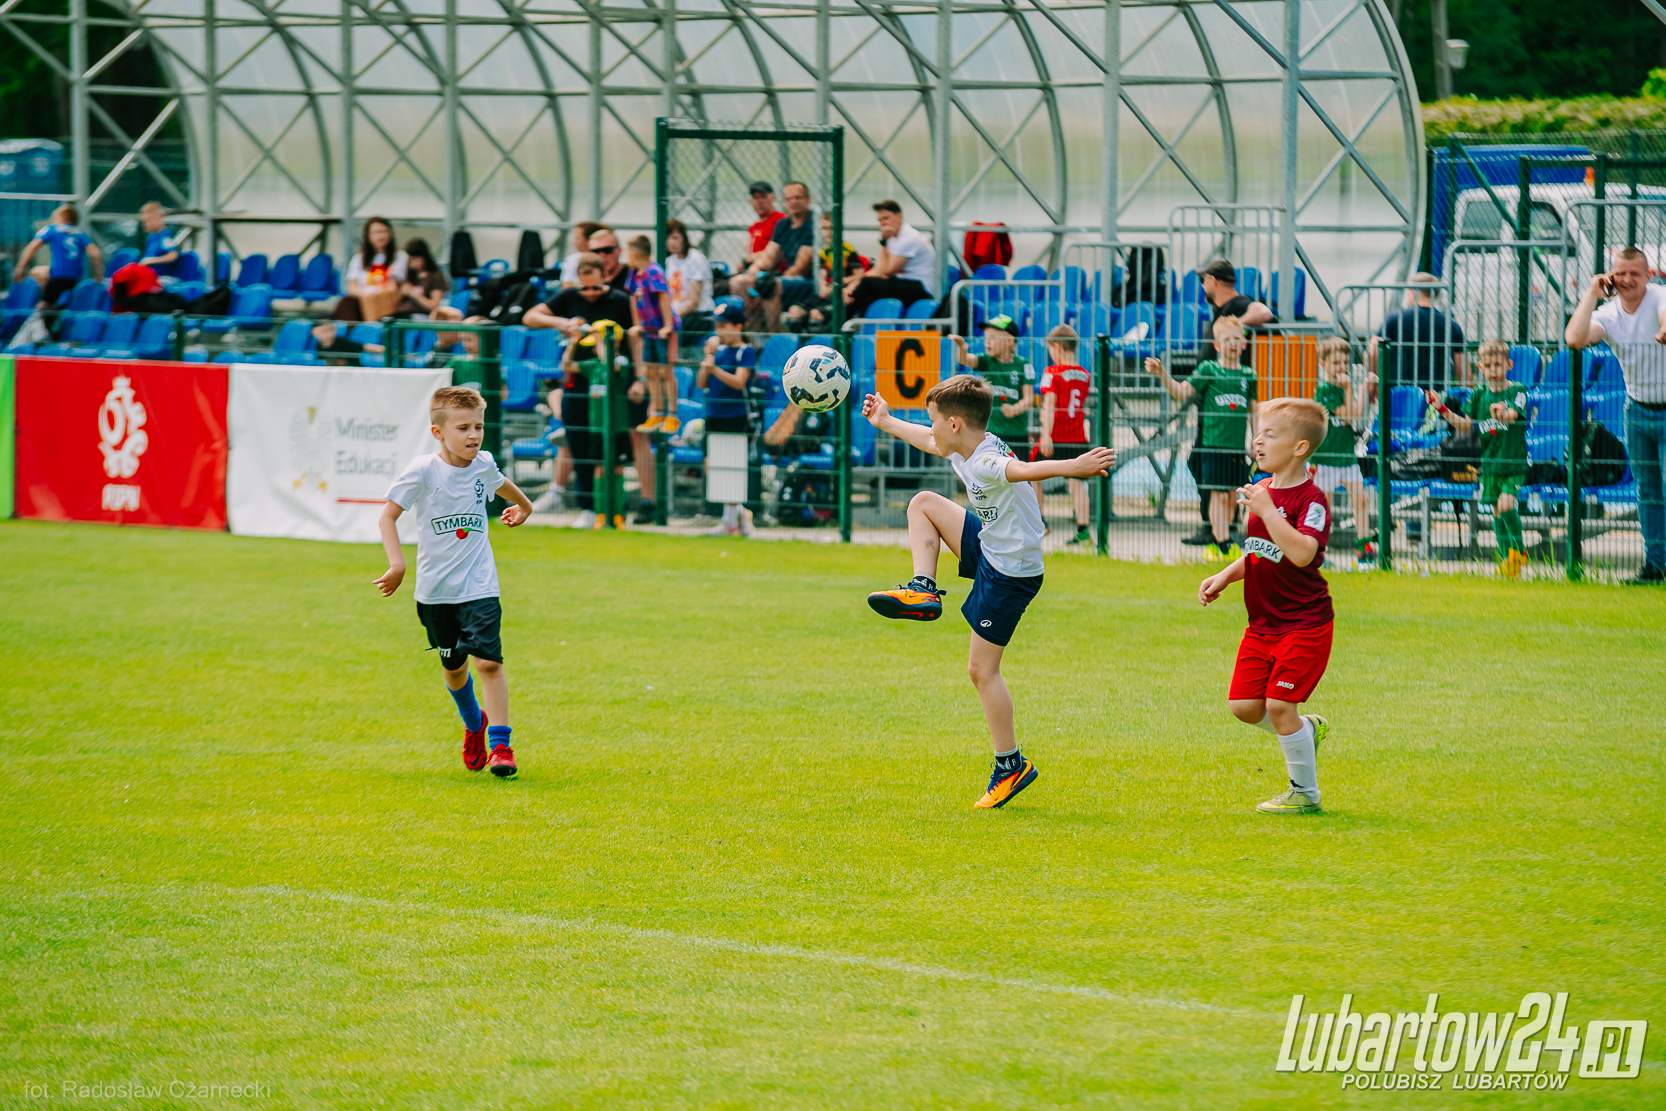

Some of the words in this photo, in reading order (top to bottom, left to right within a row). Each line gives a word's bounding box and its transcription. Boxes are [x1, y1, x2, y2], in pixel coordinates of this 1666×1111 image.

[896, 338, 925, 399] C
[335, 417, 399, 441] Minister
[434, 516, 483, 531] TYMBARK
